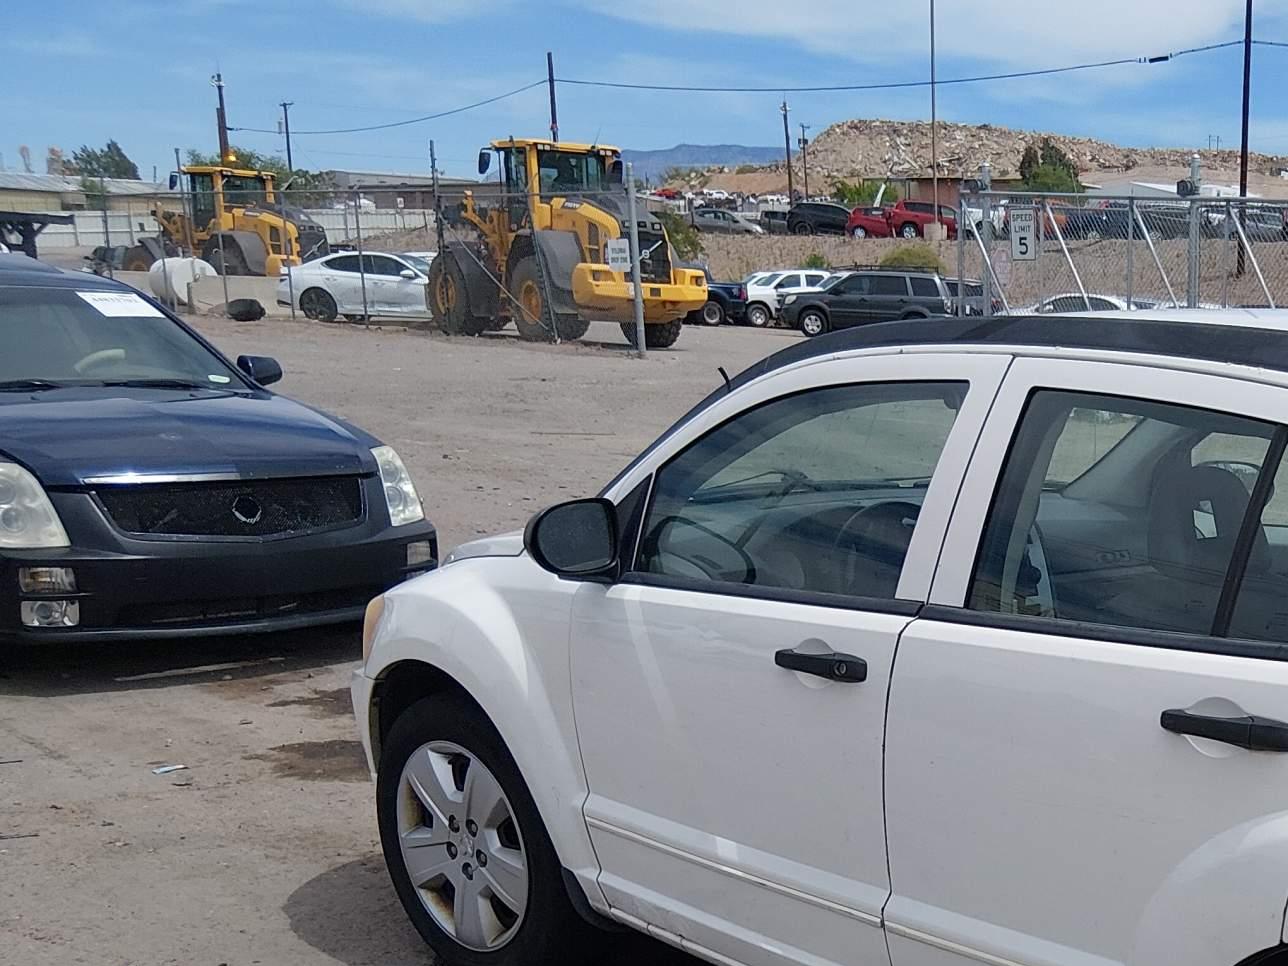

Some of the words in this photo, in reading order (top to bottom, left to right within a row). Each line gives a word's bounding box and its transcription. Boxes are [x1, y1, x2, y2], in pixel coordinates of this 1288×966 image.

[1012, 213, 1033, 223] SPEED
[1014, 225, 1031, 234] LIMIT
[1018, 236, 1029, 256] 5
